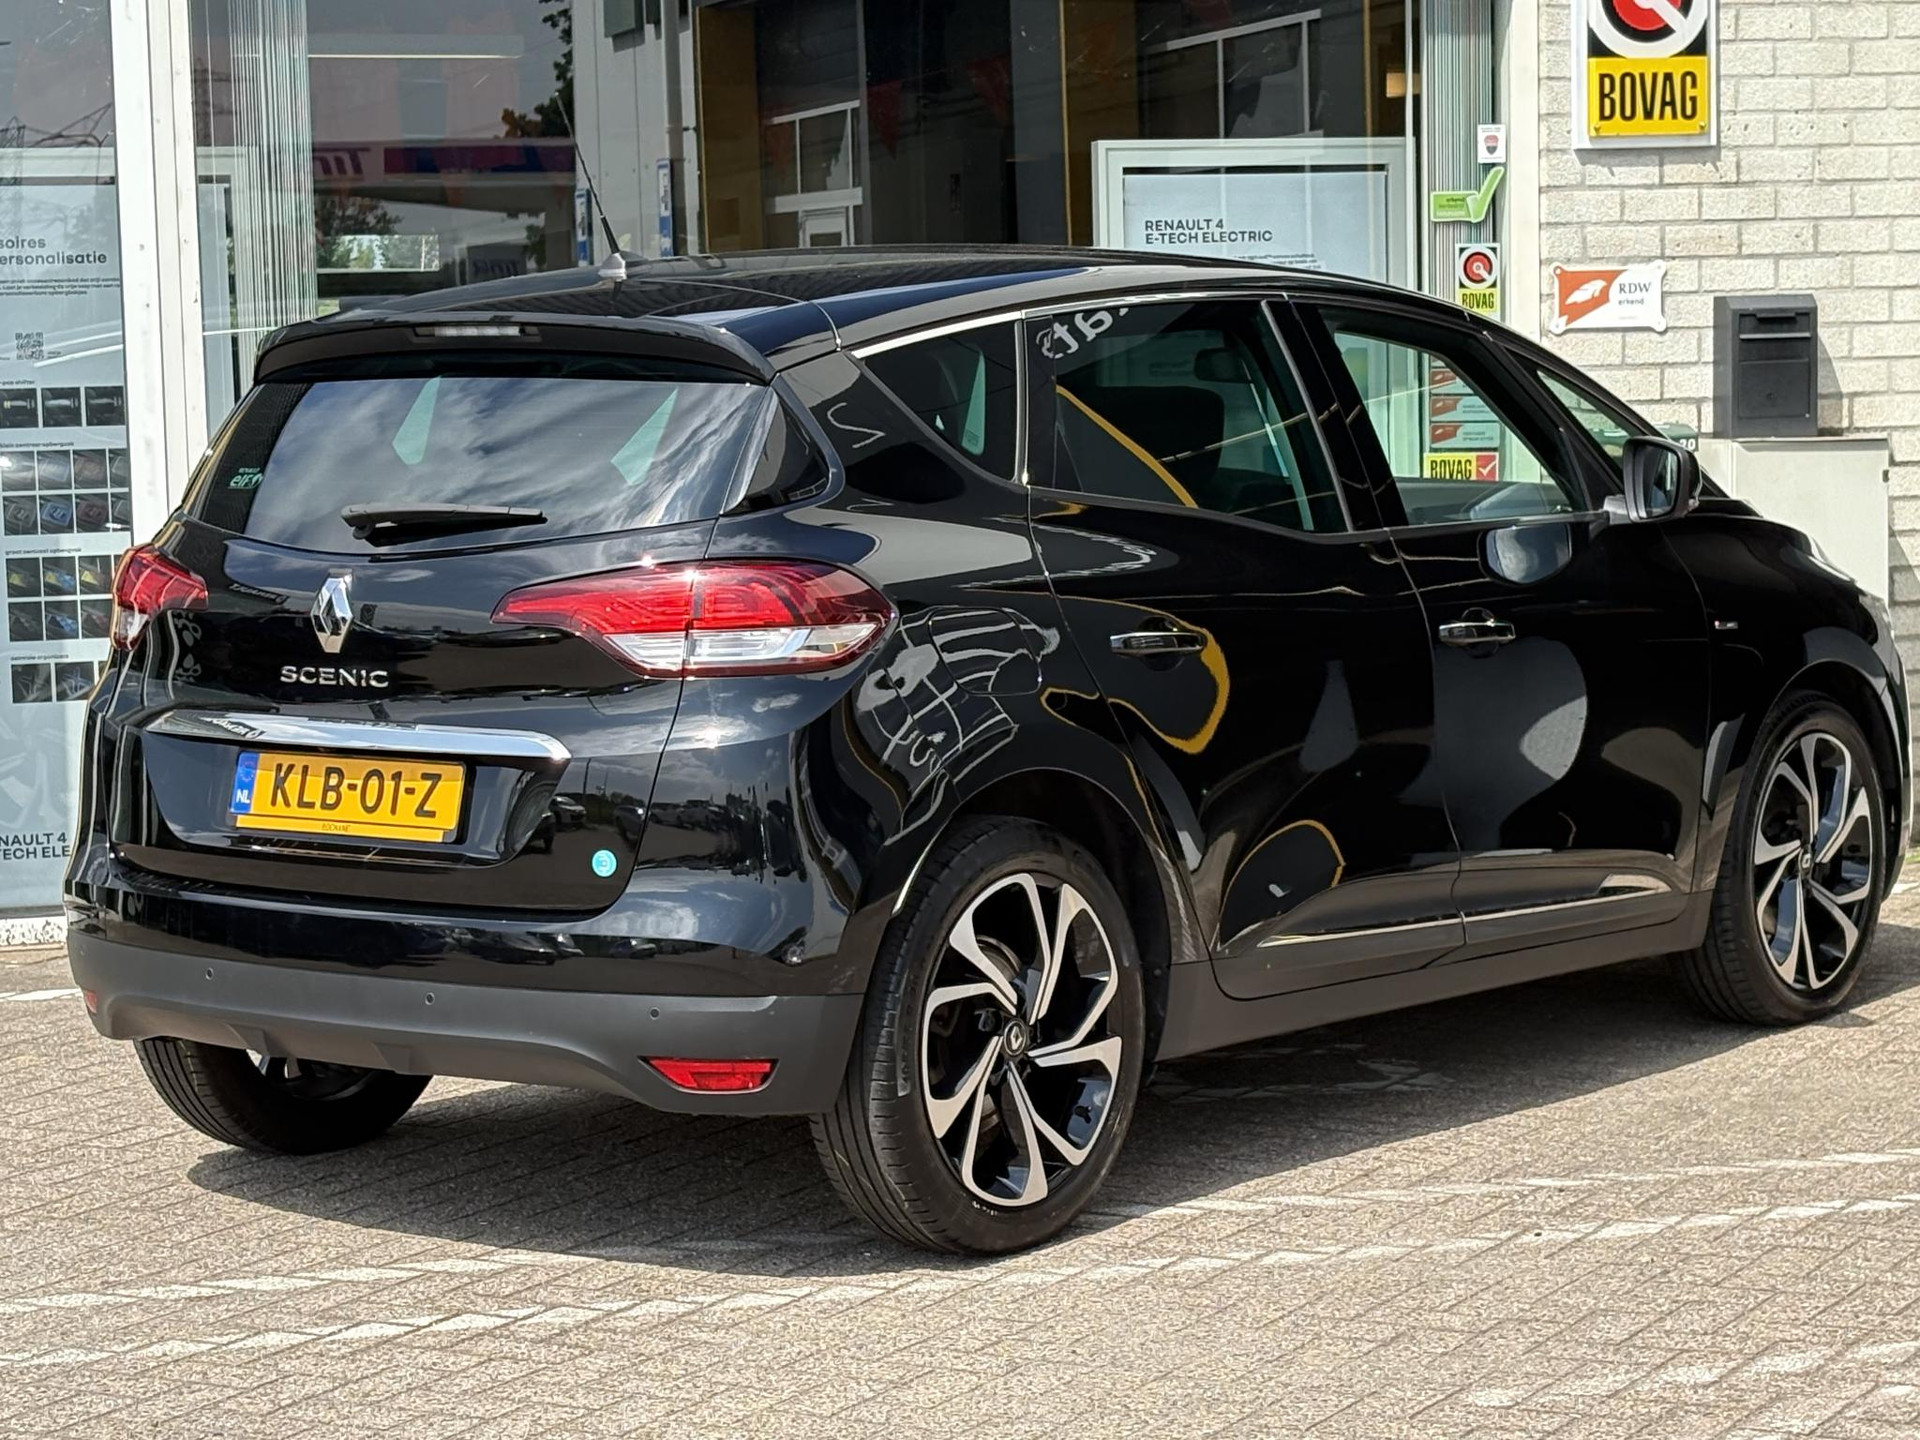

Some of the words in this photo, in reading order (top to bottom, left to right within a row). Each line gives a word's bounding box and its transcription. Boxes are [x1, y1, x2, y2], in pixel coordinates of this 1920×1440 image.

[1599, 71, 1698, 121] BOVAG
[1145, 218, 1212, 231] RENAULT
[1215, 218, 1224, 229] 4
[1145, 232, 1199, 244] E-TECH
[1202, 230, 1273, 243] ELECTRIC
[0, 250, 107, 266] ersonalisatie
[1618, 281, 1652, 294] RDW
[1462, 292, 1495, 309] BOVAG
[1618, 297, 1645, 306] erkend
[1430, 459, 1472, 480] BOVAG
[280, 665, 389, 688] SCENIC
[236, 788, 251, 804] NL
[270, 763, 443, 819] KLB-01-Z
[0, 832, 54, 847] NAULT
[57, 831, 67, 844] 4
[0, 846, 37, 860] ECH
